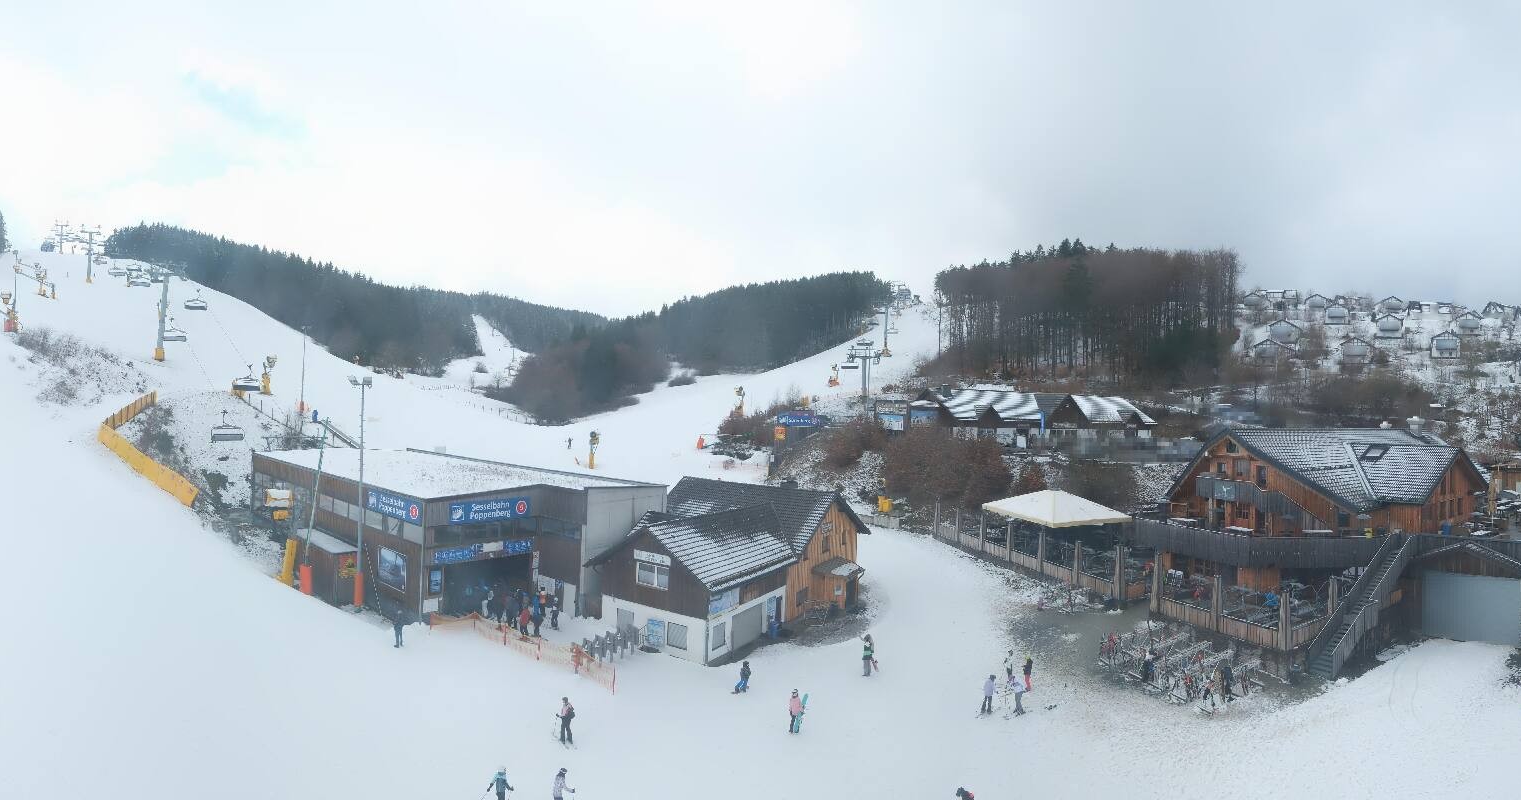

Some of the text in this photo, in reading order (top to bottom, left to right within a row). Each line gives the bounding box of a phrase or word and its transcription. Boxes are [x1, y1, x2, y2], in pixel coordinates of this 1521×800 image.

[378, 502, 406, 519] Poppenberg
[471, 501, 510, 511] Sesselbahn
[470, 510, 511, 520] Poppenberg
